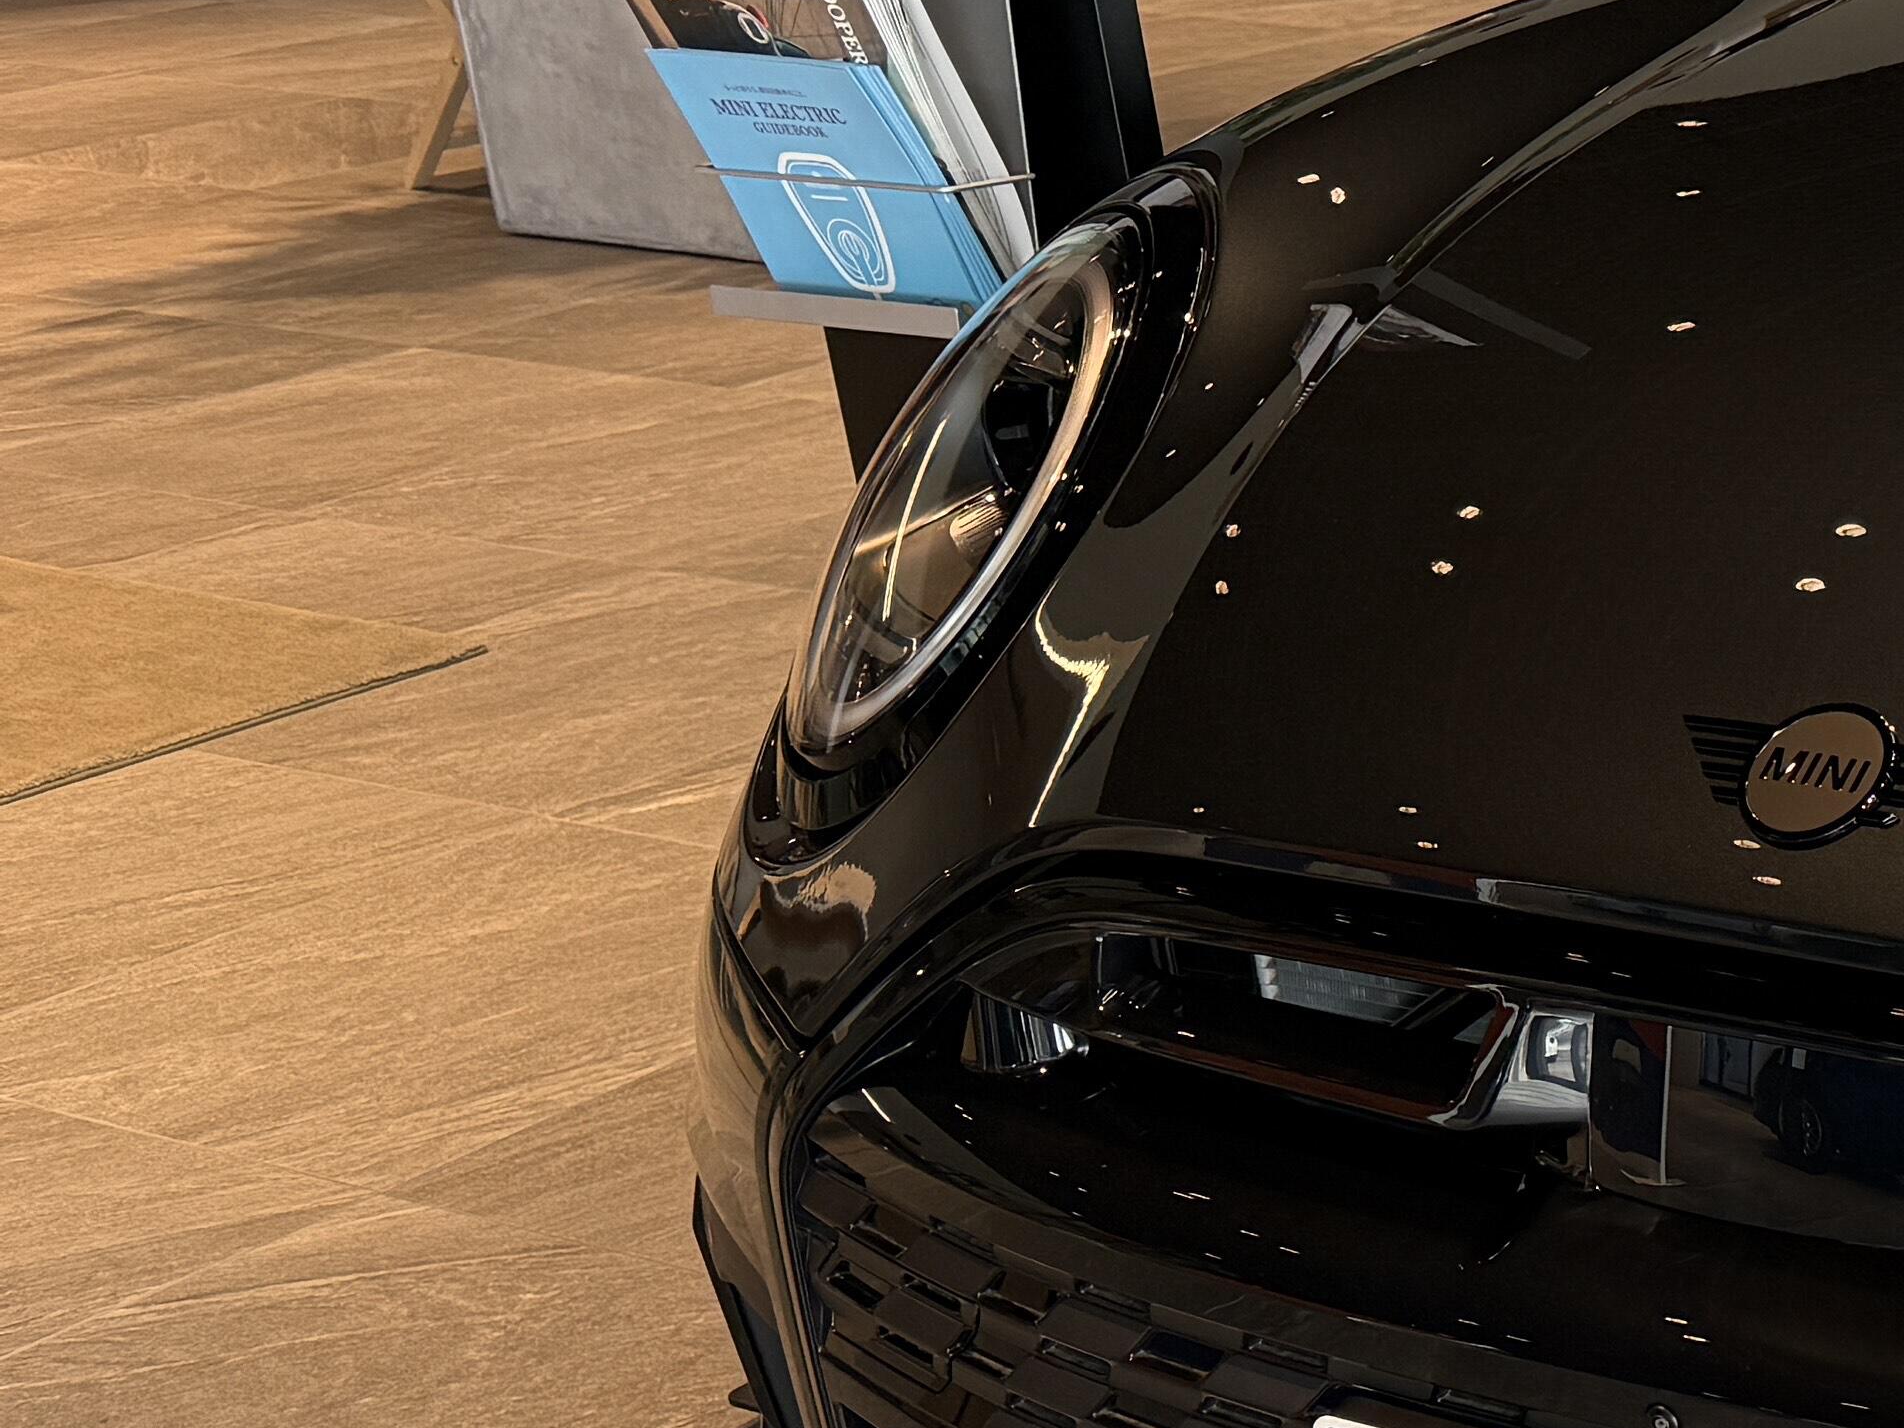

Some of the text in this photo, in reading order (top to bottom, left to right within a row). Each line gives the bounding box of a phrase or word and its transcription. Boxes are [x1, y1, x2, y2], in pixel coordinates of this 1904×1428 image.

[709, 97, 848, 126] MINI ELECTRIC
[753, 121, 829, 139] GUIDEBOOK
[1759, 746, 1872, 794] MINI
